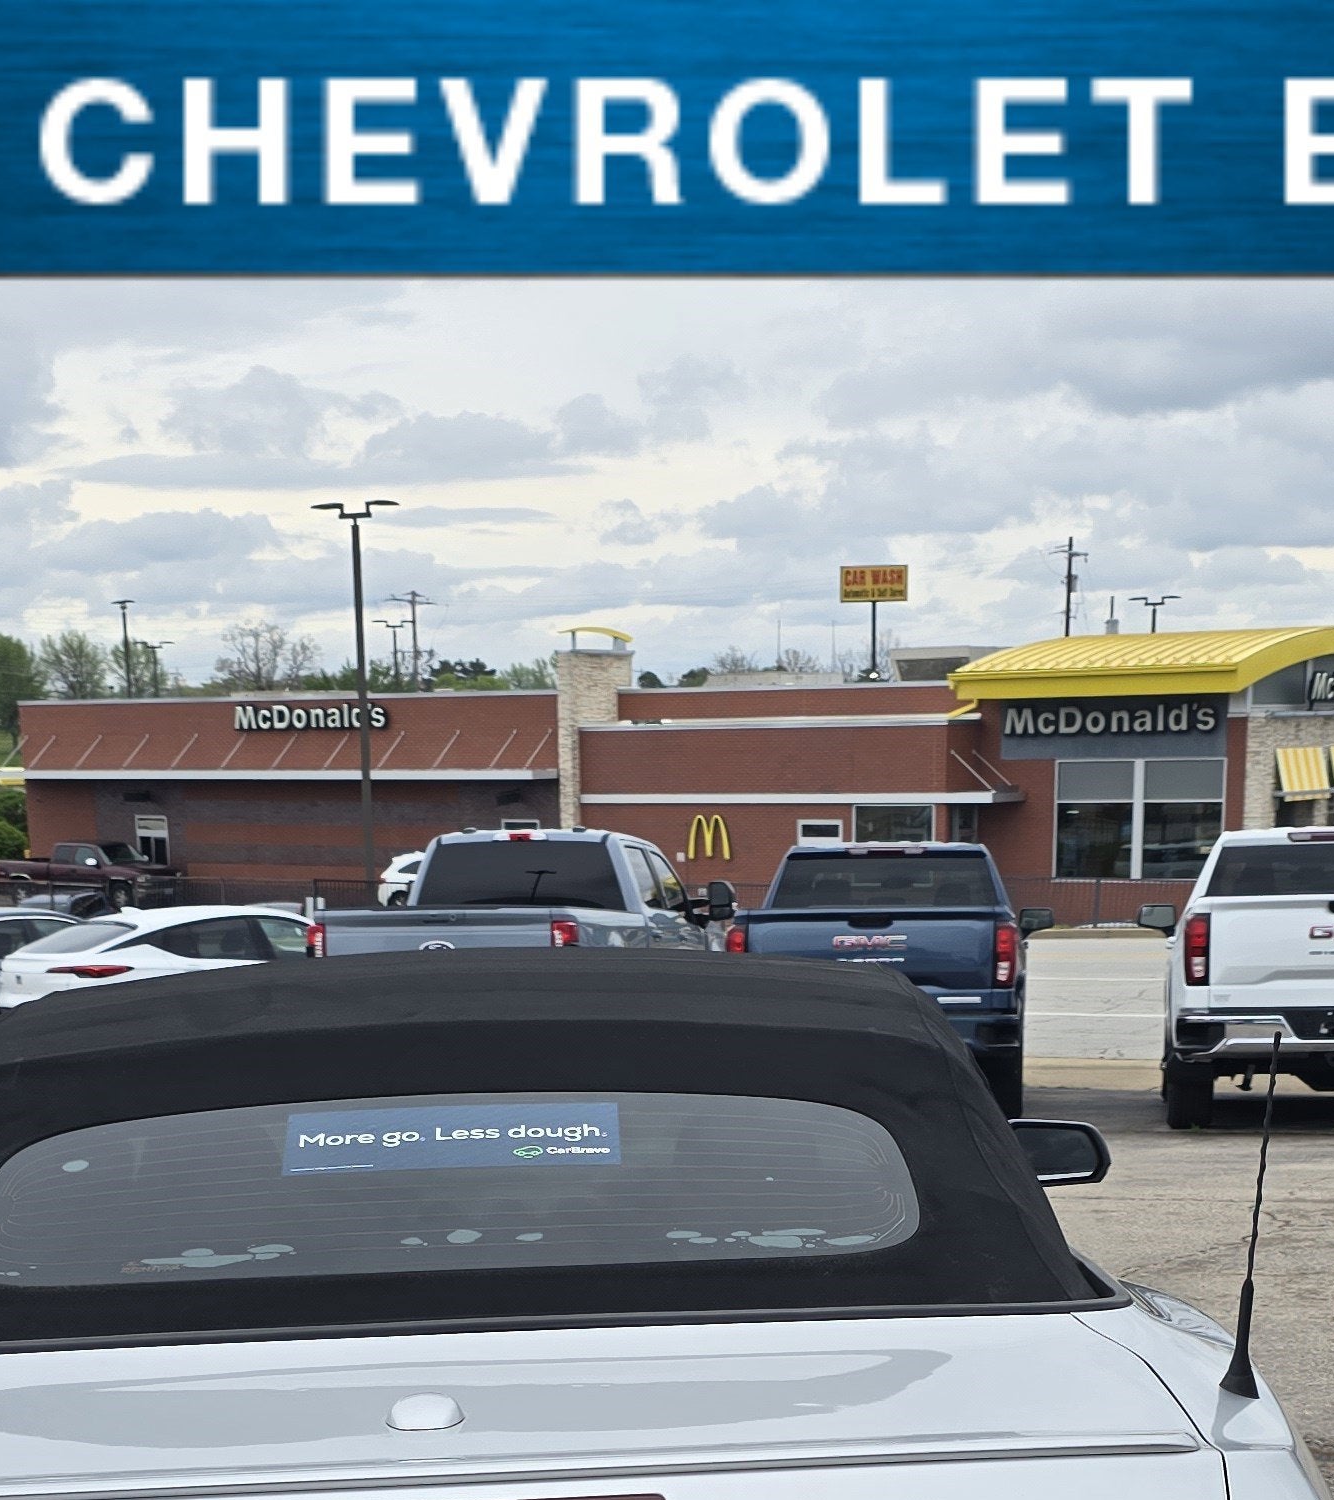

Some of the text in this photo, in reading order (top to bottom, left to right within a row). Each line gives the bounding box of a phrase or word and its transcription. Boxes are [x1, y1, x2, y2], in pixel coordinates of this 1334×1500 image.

[844, 568, 904, 586] CAR WASH
[1004, 702, 1216, 735] McDonald's
[832, 934, 907, 951] GMC
[298, 1123, 609, 1148] More go. Less dough.
